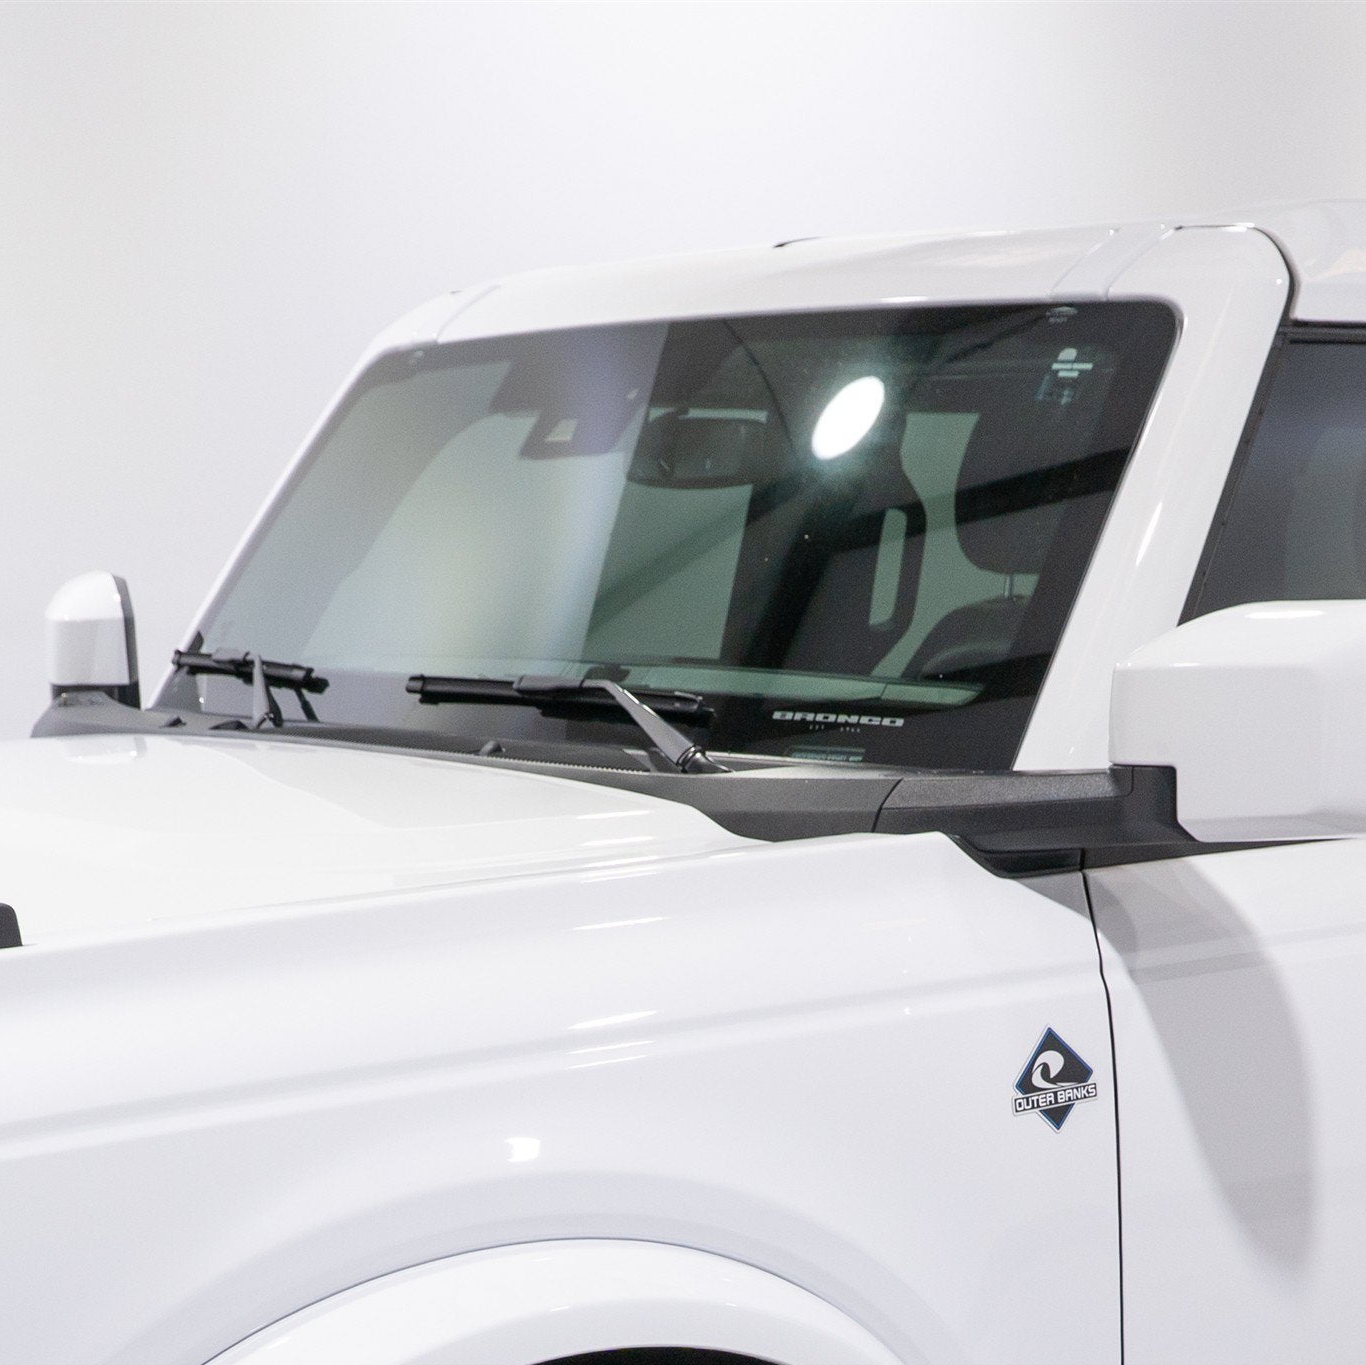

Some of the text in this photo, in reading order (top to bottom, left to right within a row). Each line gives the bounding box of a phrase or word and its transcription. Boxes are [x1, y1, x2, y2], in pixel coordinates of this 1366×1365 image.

[772, 711, 904, 727] BRONCO
[1016, 1085, 1096, 1111] OUTER BANKS
